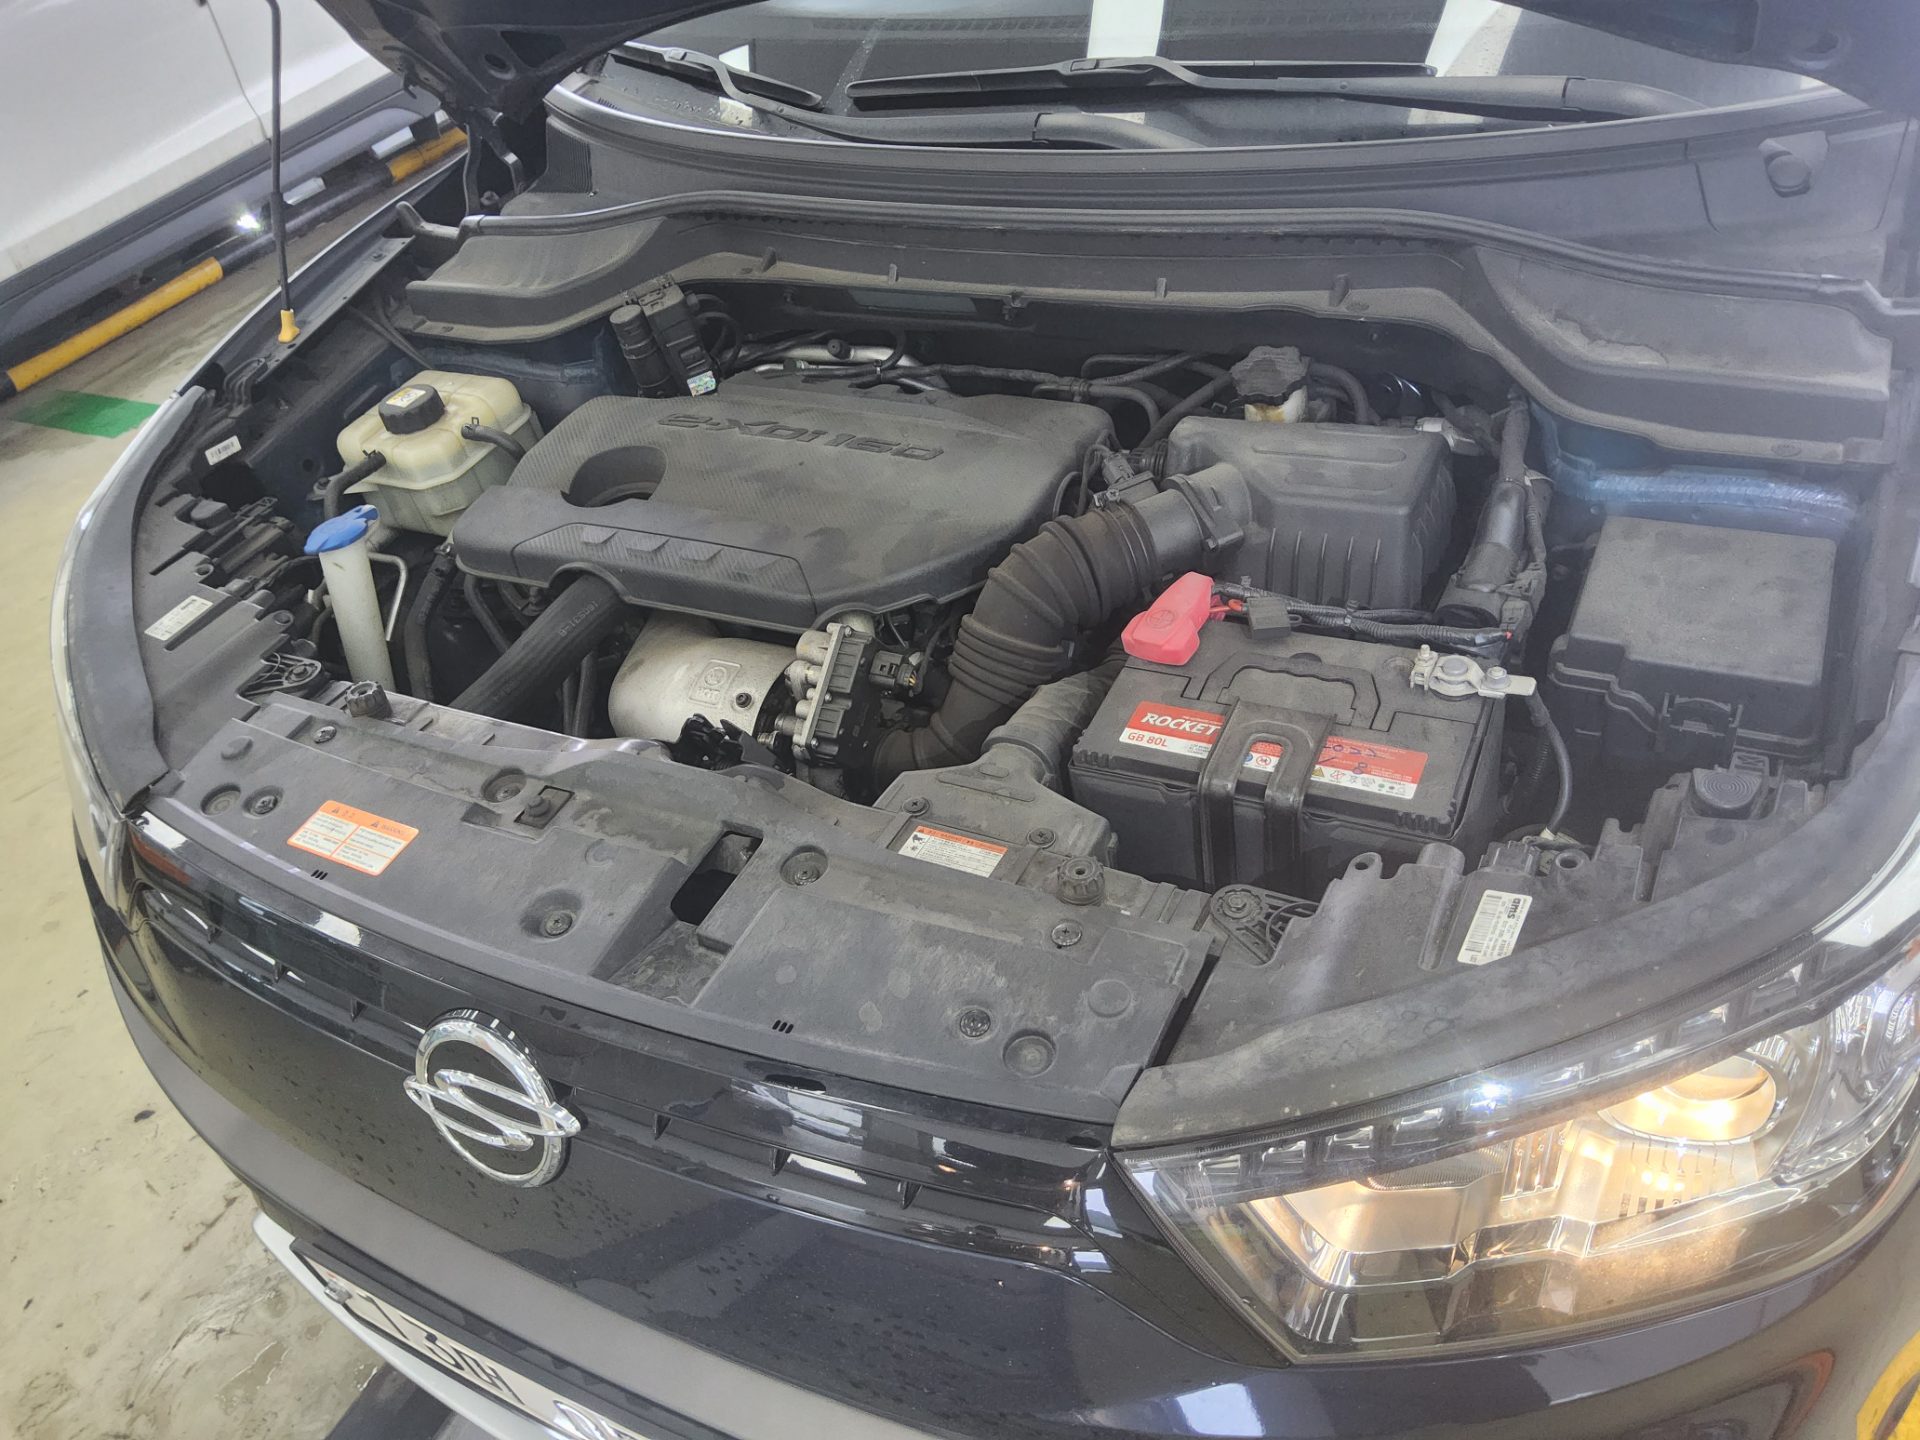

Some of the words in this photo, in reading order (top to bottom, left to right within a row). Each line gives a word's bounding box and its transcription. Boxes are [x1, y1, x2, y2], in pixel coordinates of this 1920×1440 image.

[1140, 712, 1222, 736] ROCKET
[1127, 732, 1145, 743] GB
[1147, 736, 1168, 748] 80L
